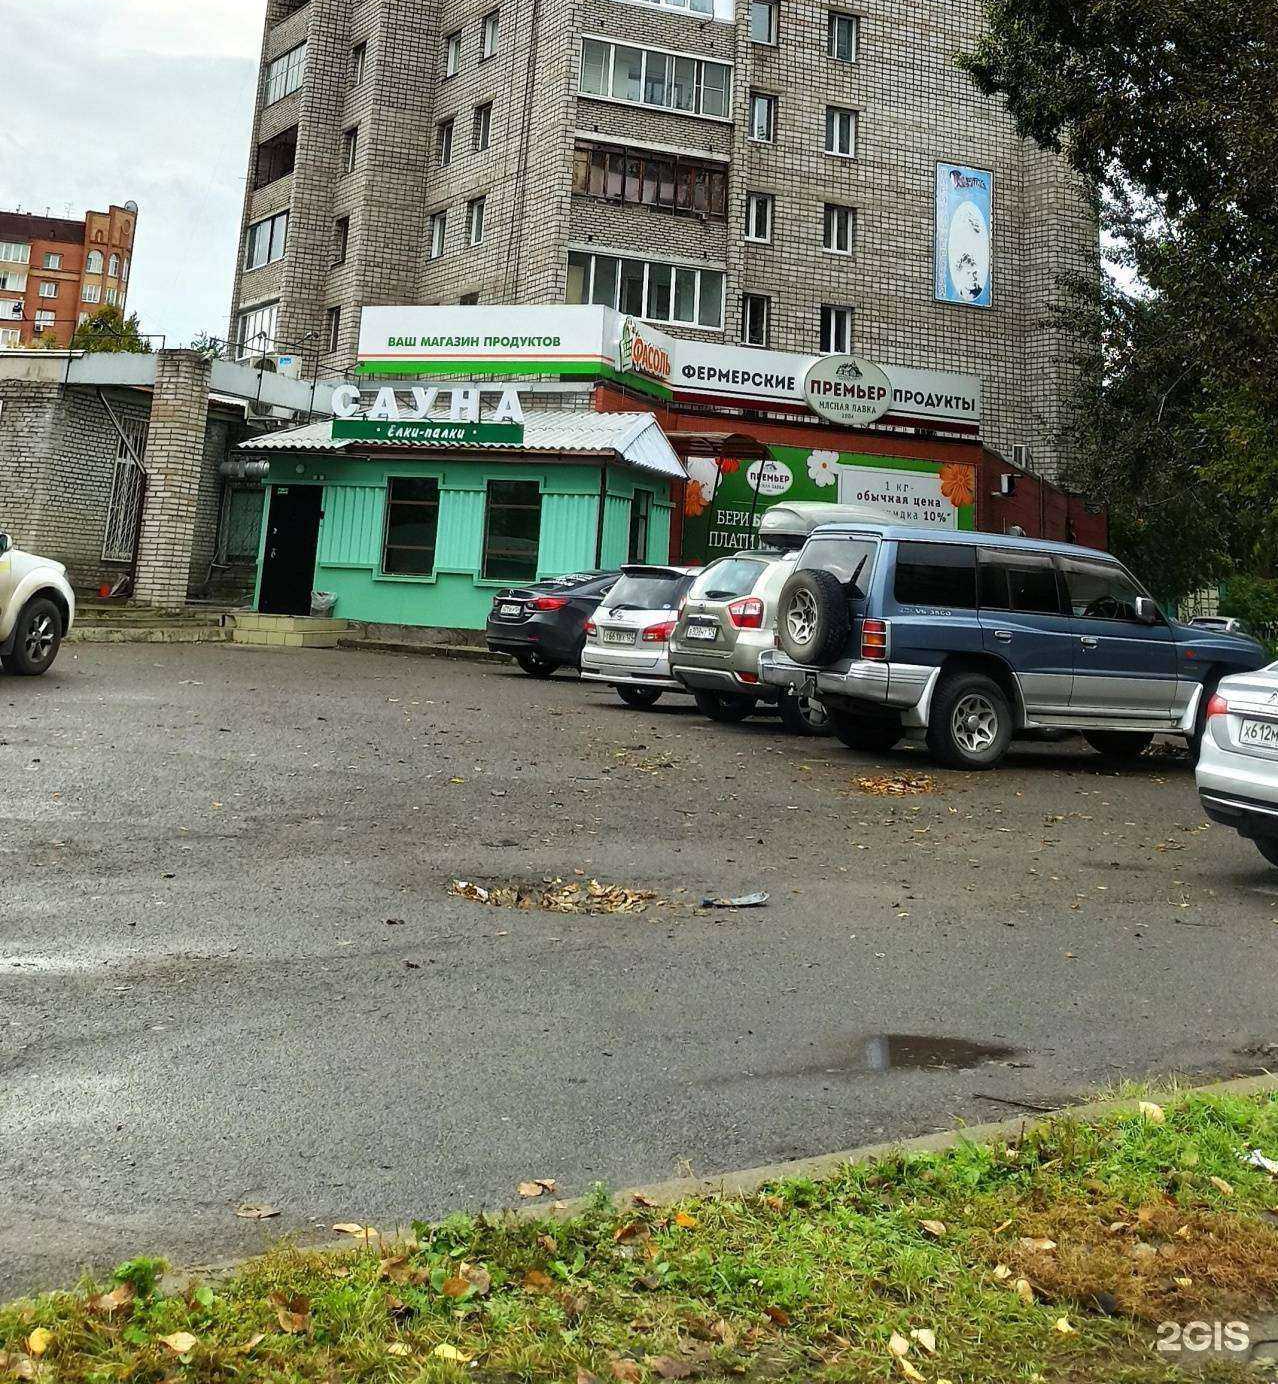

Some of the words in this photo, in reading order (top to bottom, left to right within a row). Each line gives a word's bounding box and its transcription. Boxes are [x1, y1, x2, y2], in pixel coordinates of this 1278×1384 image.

[388, 336, 417, 347] ВАШ
[420, 336, 480, 347] МАГАЗИН
[483, 336, 561, 349] ПРОДУКТОВ
[632, 337, 671, 377] ФАСОЛЬ
[681, 364, 796, 391] ФЕРМЕРСКИЕ
[810, 379, 887, 401] ПРЕМЬЕР
[331, 384, 525, 423] САУНА
[851, 403, 877, 415] ЛАВКА
[893, 388, 976, 412] ПРОДУКТЫ
[885, 481, 890, 491] 1
[856, 490, 909, 505] обычная
[913, 496, 941, 508] цена
[717, 509, 750, 525] БЕРИ
[708, 531, 754, 550] ПЛАТИ
